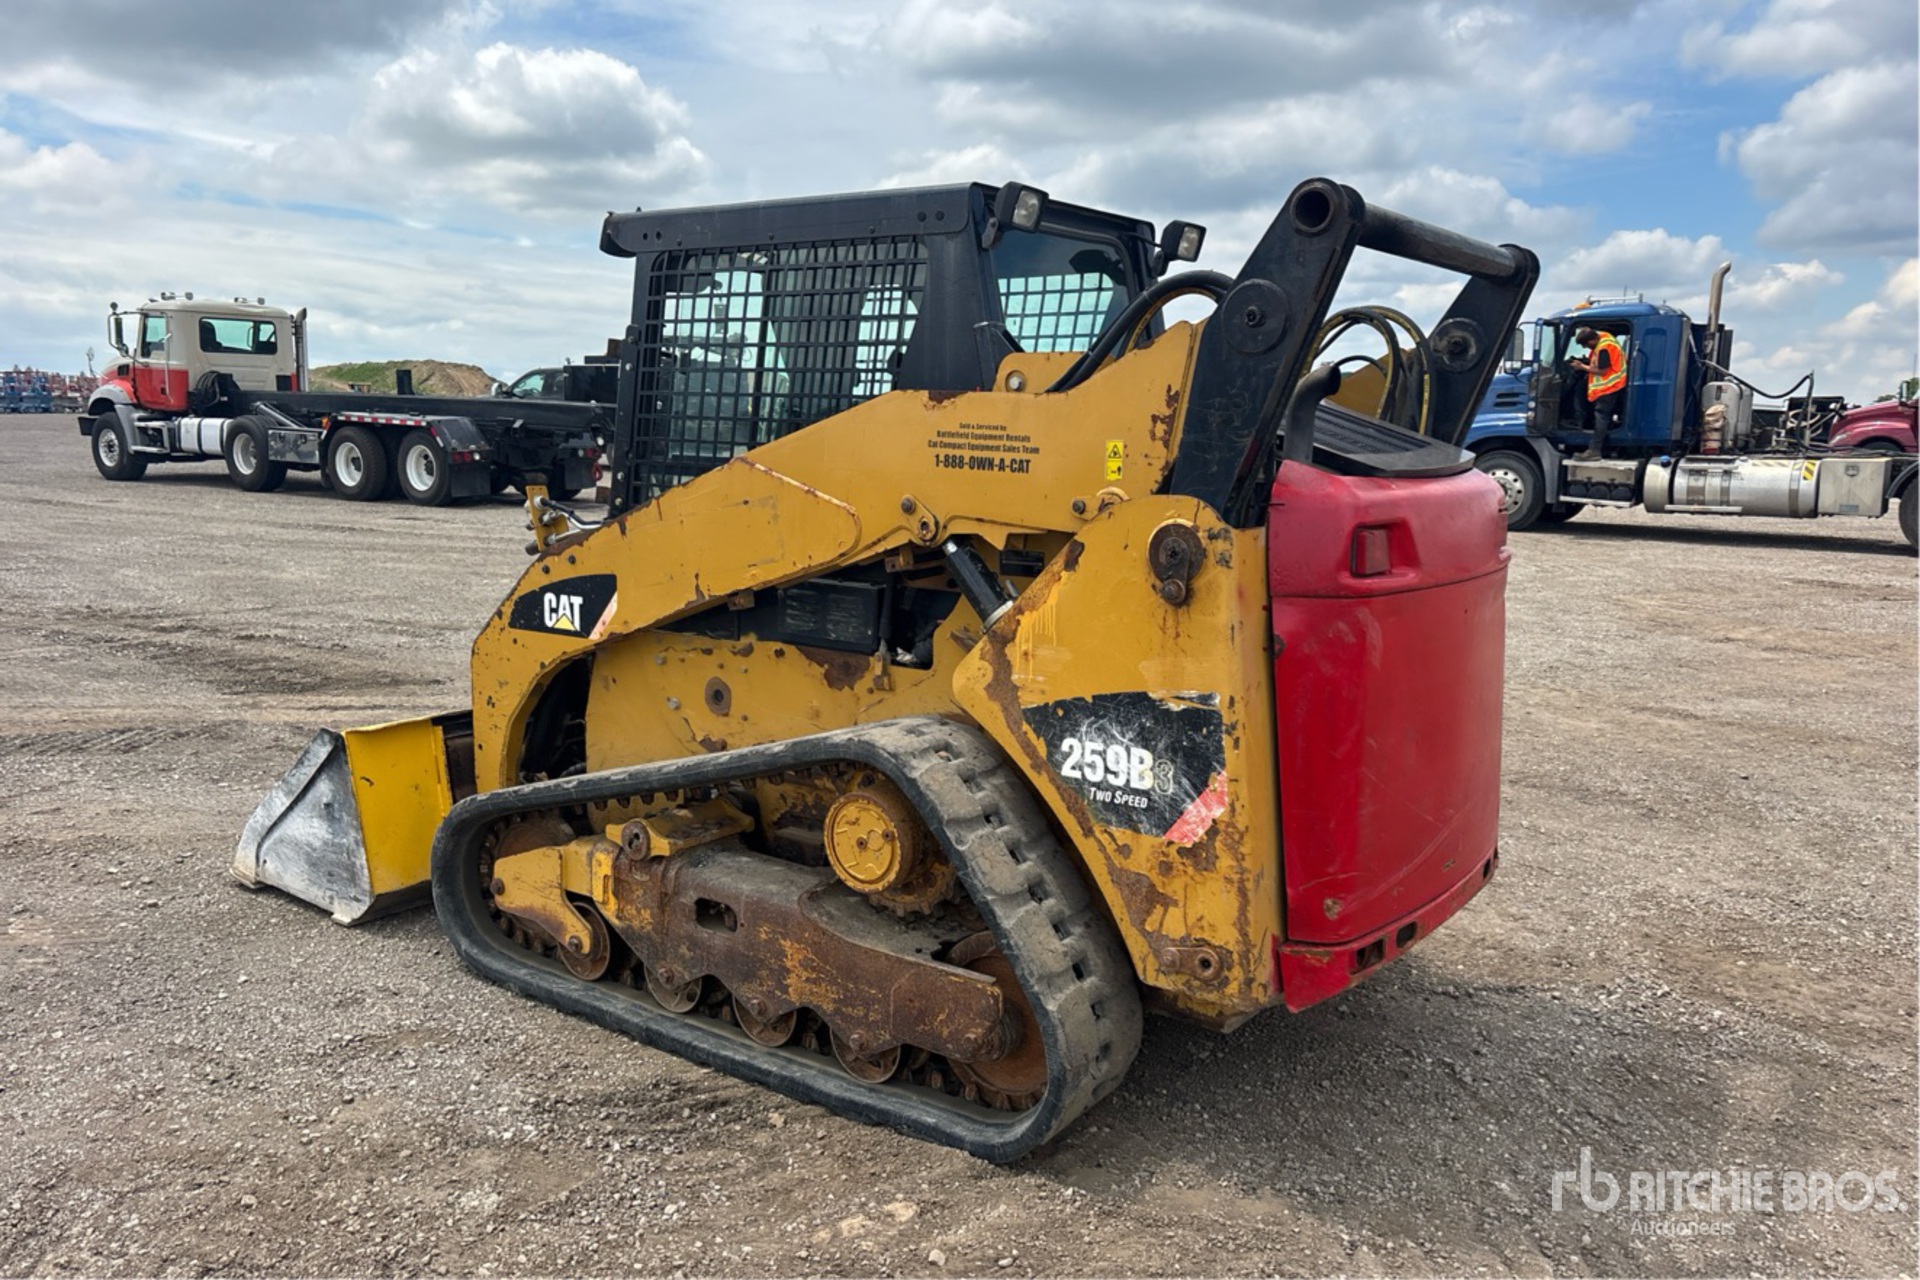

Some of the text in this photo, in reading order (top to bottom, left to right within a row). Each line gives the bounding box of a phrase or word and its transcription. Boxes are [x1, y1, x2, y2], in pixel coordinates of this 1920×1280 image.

[971, 431, 1004, 441] Equipment
[1006, 433, 1031, 443] Rentals
[939, 440, 967, 450] Compact
[967, 442, 1001, 452] Equipment
[1002, 444, 1020, 453] Sales
[1022, 445, 1039, 454] Team
[934, 453, 1031, 474] 1-888-OWN-A-CAT
[543, 592, 584, 632] CAT
